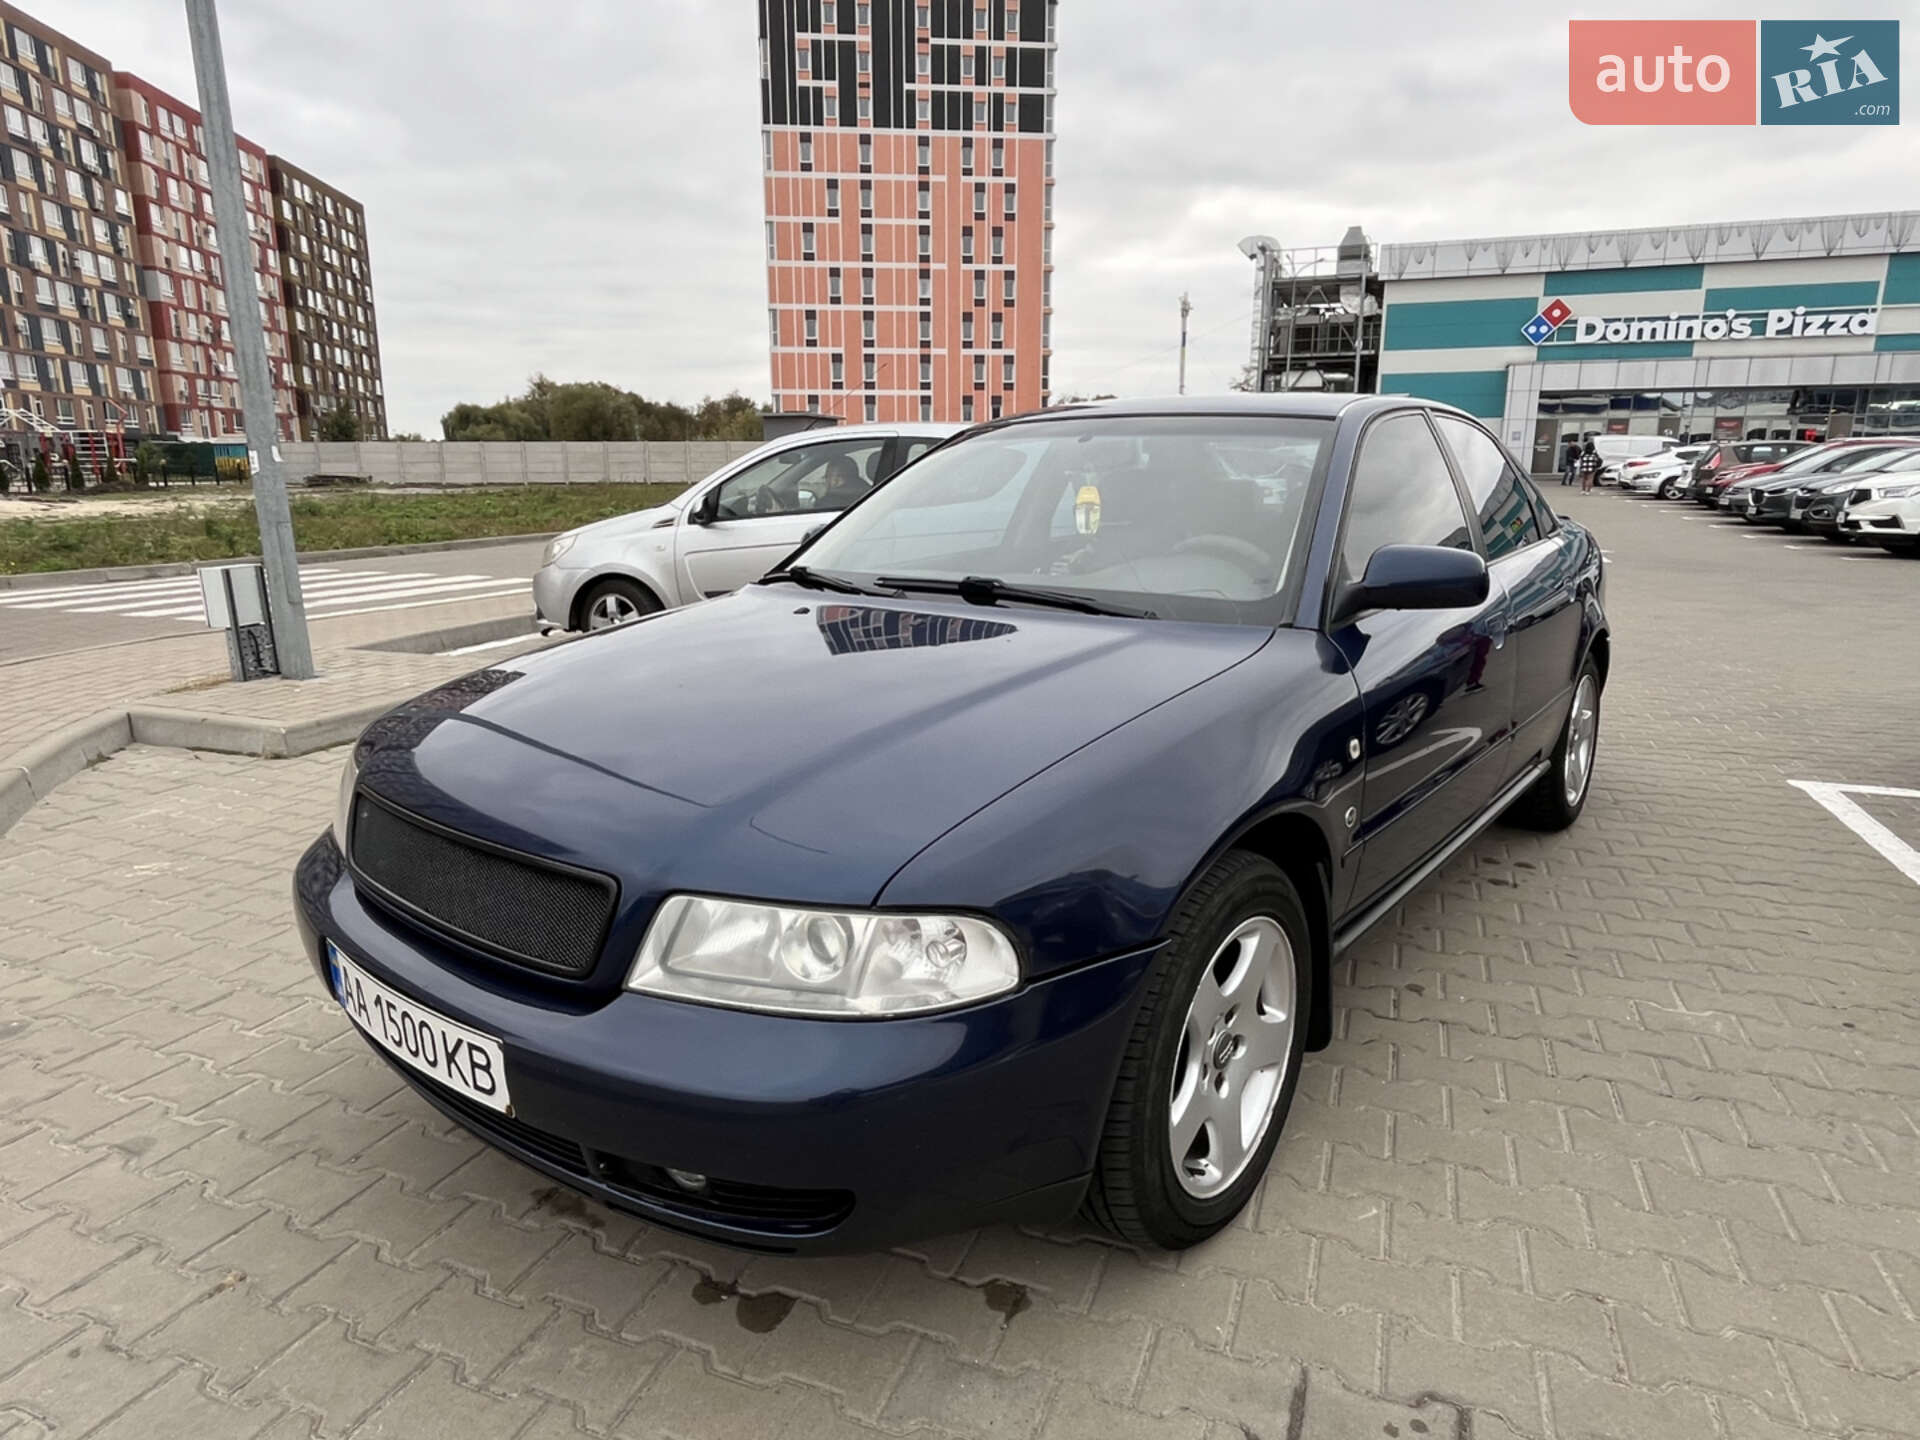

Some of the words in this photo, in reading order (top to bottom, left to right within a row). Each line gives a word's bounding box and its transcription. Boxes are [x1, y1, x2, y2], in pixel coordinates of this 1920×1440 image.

[1575, 309, 1752, 344] Domino's
[1767, 306, 1875, 337] Pizza
[342, 966, 372, 1027] AA
[374, 993, 437, 1068] 1500
[442, 1030, 496, 1096] KB
